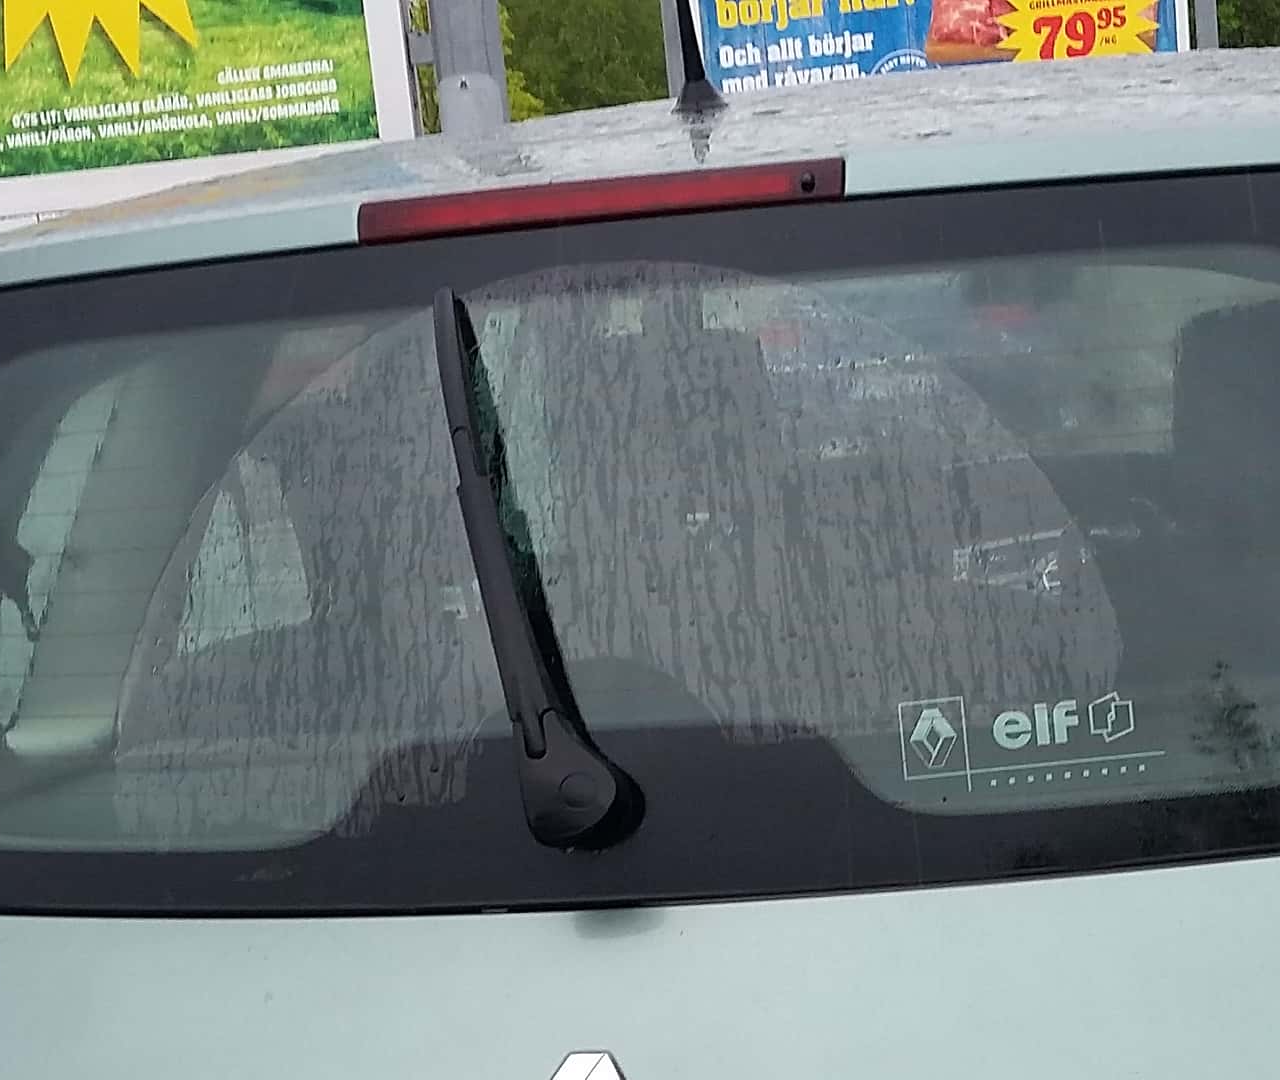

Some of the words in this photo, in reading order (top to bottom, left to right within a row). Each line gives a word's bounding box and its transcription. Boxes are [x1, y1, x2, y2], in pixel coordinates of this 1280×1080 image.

[719, 43, 761, 68] Och
[767, 36, 804, 61] allt
[808, 30, 874, 59] börjar
[992, 699, 1079, 750] elf
